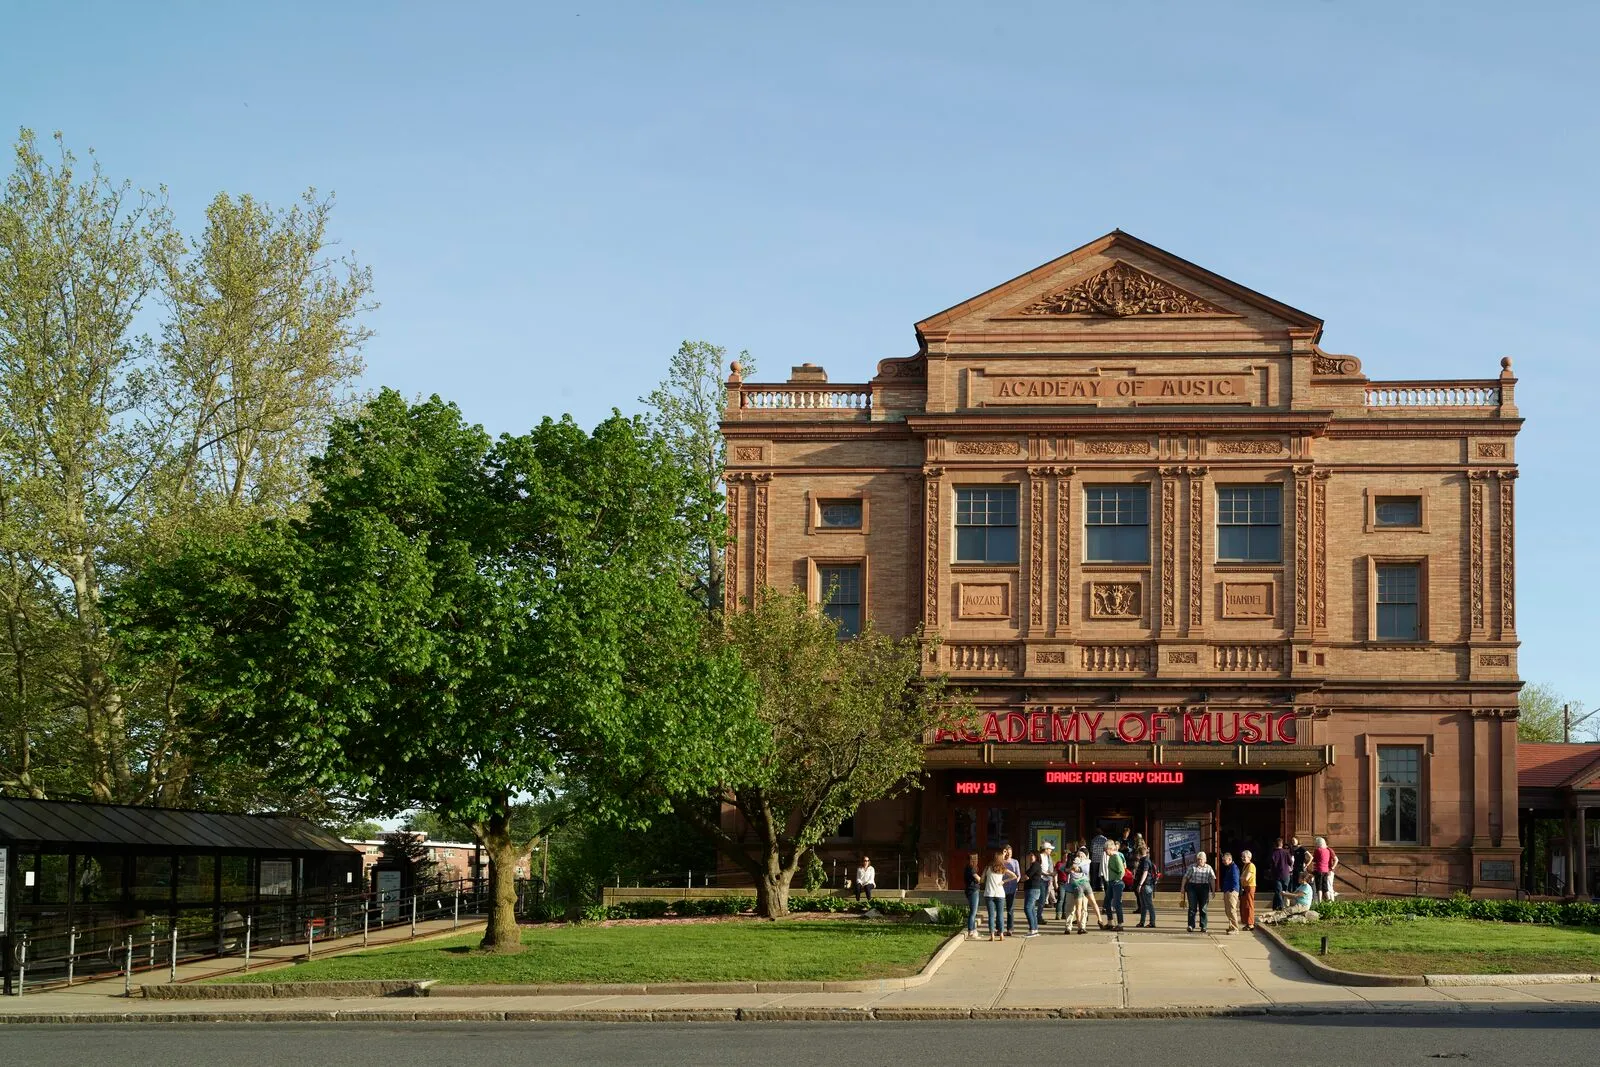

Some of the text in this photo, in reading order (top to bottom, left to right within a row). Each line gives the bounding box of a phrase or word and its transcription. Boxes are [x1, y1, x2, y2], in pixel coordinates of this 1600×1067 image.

[999, 381, 1100, 397] ACADEMY
[1116, 381, 1145, 397] OF
[965, 595, 1001, 605] MOZART
[1117, 712, 1169, 743] OF
[1183, 712, 1296, 743] MUSIC
[1046, 772, 1184, 783] DANCE FOR EVERY CHILD
[956, 782, 996, 794] MAY 19
[1235, 783, 1259, 795] 3PM
